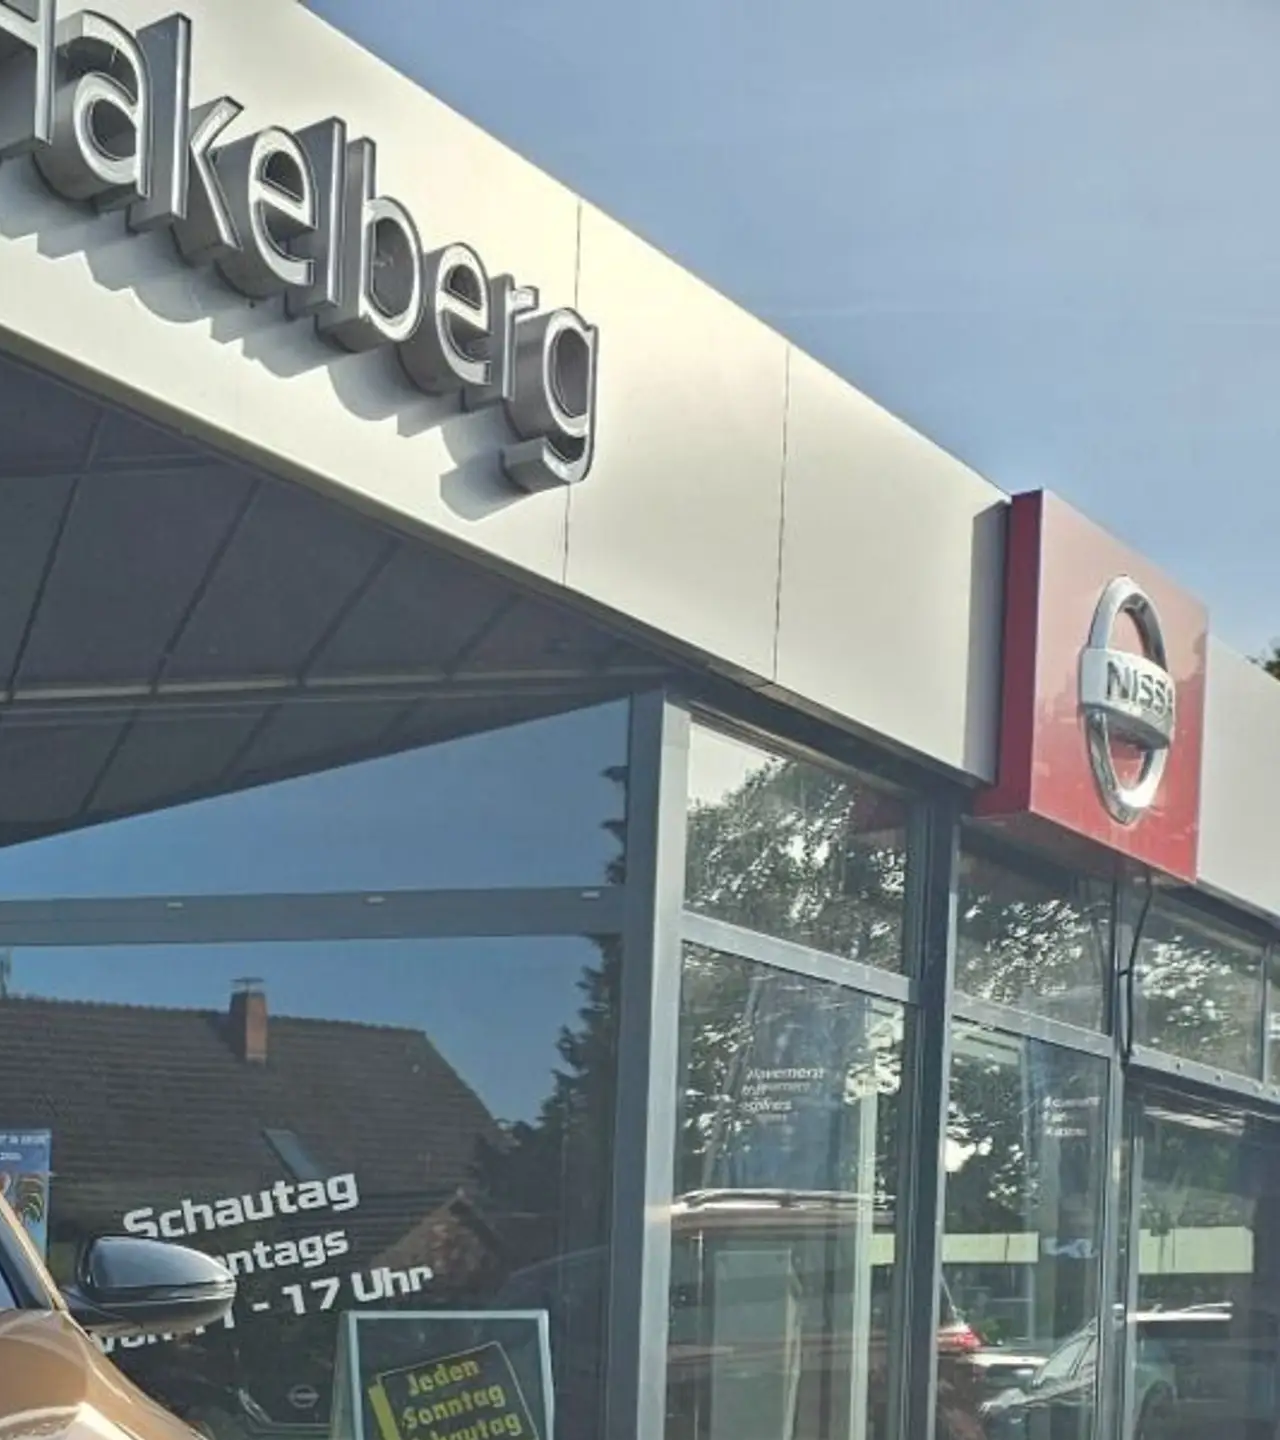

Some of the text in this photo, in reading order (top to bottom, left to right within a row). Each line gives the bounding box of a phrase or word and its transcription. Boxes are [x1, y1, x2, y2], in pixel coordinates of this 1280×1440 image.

[124, 1173, 360, 1239] Schautag
[281, 1277, 341, 1315] 17
[352, 1265, 435, 1302] Uhr
[406, 1359, 480, 1396] Jeden
[402, 1385, 506, 1430] Sonntag
